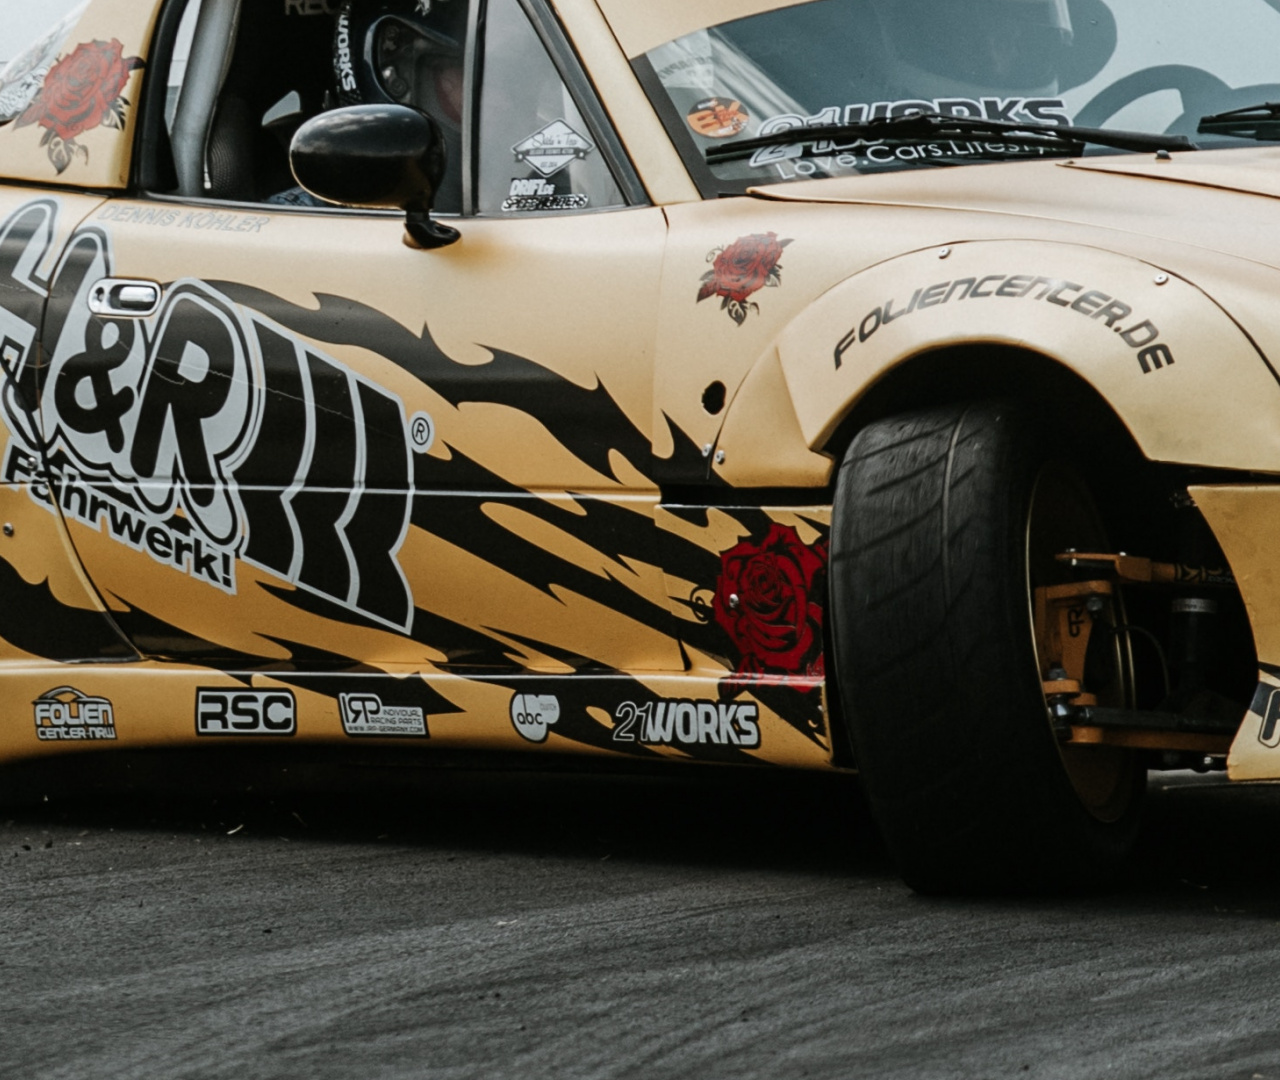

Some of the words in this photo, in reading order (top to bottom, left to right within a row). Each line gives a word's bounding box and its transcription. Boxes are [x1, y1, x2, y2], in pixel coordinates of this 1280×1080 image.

[97, 203, 181, 227] DENNIS
[178, 210, 270, 233] KÖHLER
[834, 273, 1175, 374] FOLIENCENTER.DE
[5, 444, 235, 590] Fahrwerk!
[35, 703, 113, 726] FOLIEN
[200, 694, 293, 730] RSC
[612, 700, 760, 746] 21WORKS
[37, 727, 116, 740] CENTER-NRW
